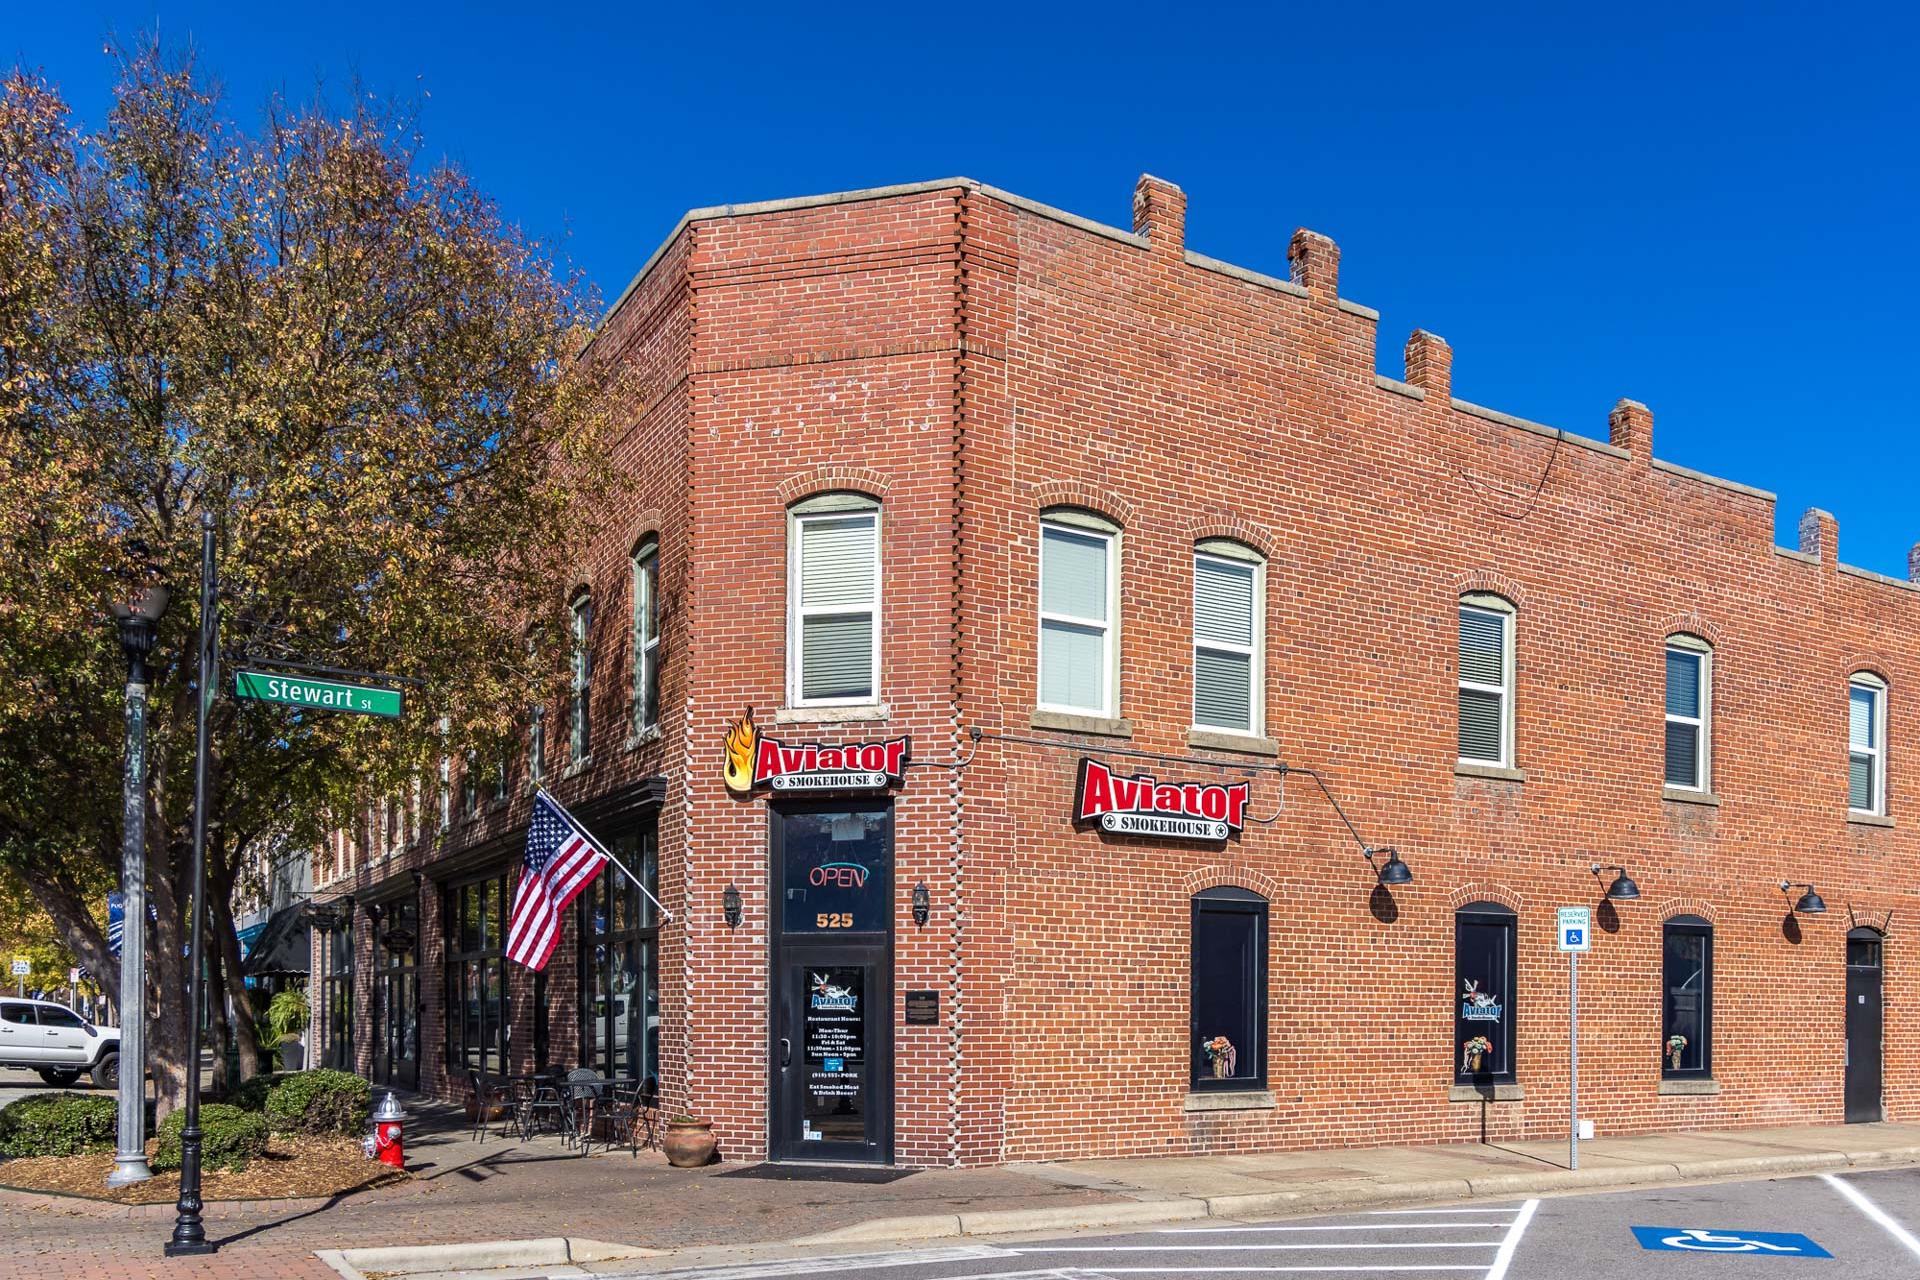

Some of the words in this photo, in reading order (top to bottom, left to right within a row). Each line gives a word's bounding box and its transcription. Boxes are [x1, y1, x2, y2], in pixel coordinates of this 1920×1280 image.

[268, 680, 353, 707] Stewart
[361, 699, 372, 710] St
[755, 738, 907, 783] Aviator
[788, 775, 870, 787] SMOKEHOUSE
[1081, 762, 1249, 830] Aviator
[1121, 817, 1211, 836] SMOKEHOUSE
[810, 867, 865, 888] OPEN
[816, 913, 853, 928] 525
[811, 993, 858, 1008] Aviator
[1462, 1002, 1502, 1018] Aviator
